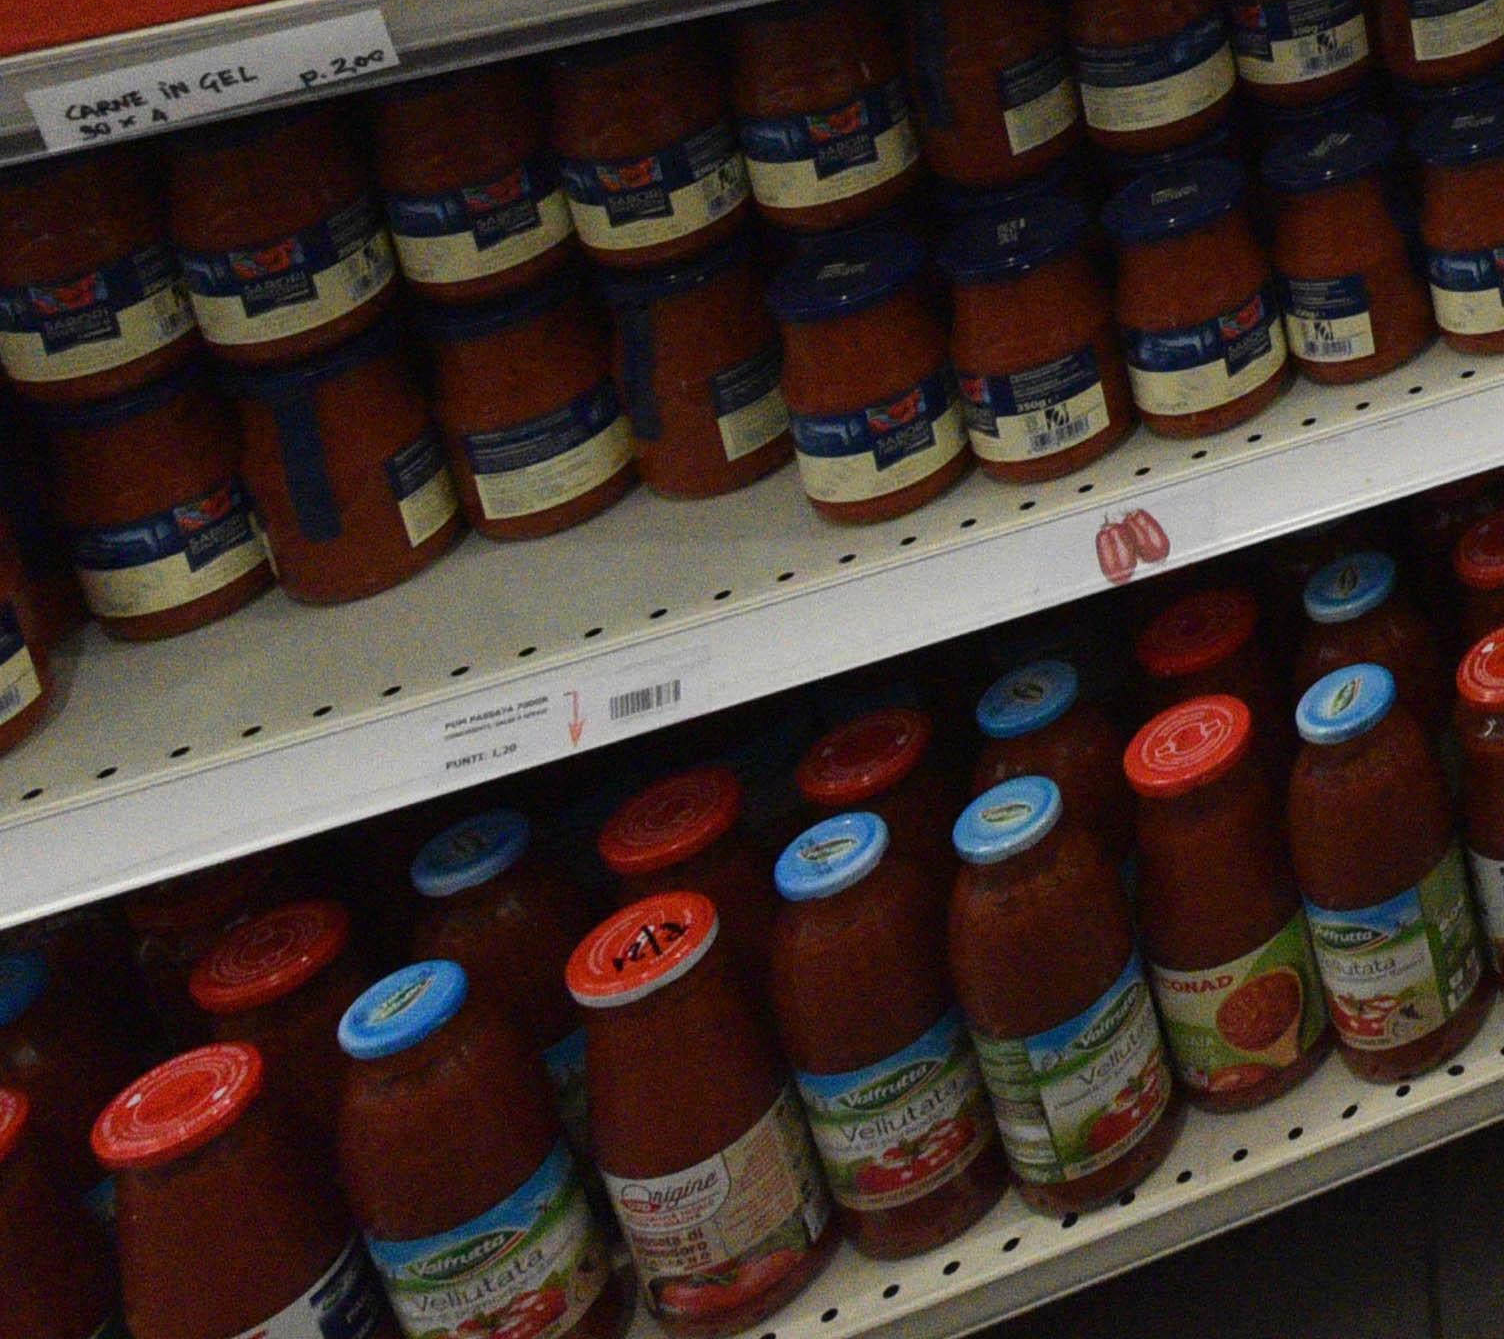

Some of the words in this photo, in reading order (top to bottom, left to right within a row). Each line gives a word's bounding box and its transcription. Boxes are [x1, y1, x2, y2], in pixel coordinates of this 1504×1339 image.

[65, 90, 147, 121] CARNE
[200, 66, 257, 93] GEL
[840, 1083, 962, 1144] Vellutata
[844, 1062, 941, 1111] Valfrutta
[411, 1248, 545, 1316] Vellutata
